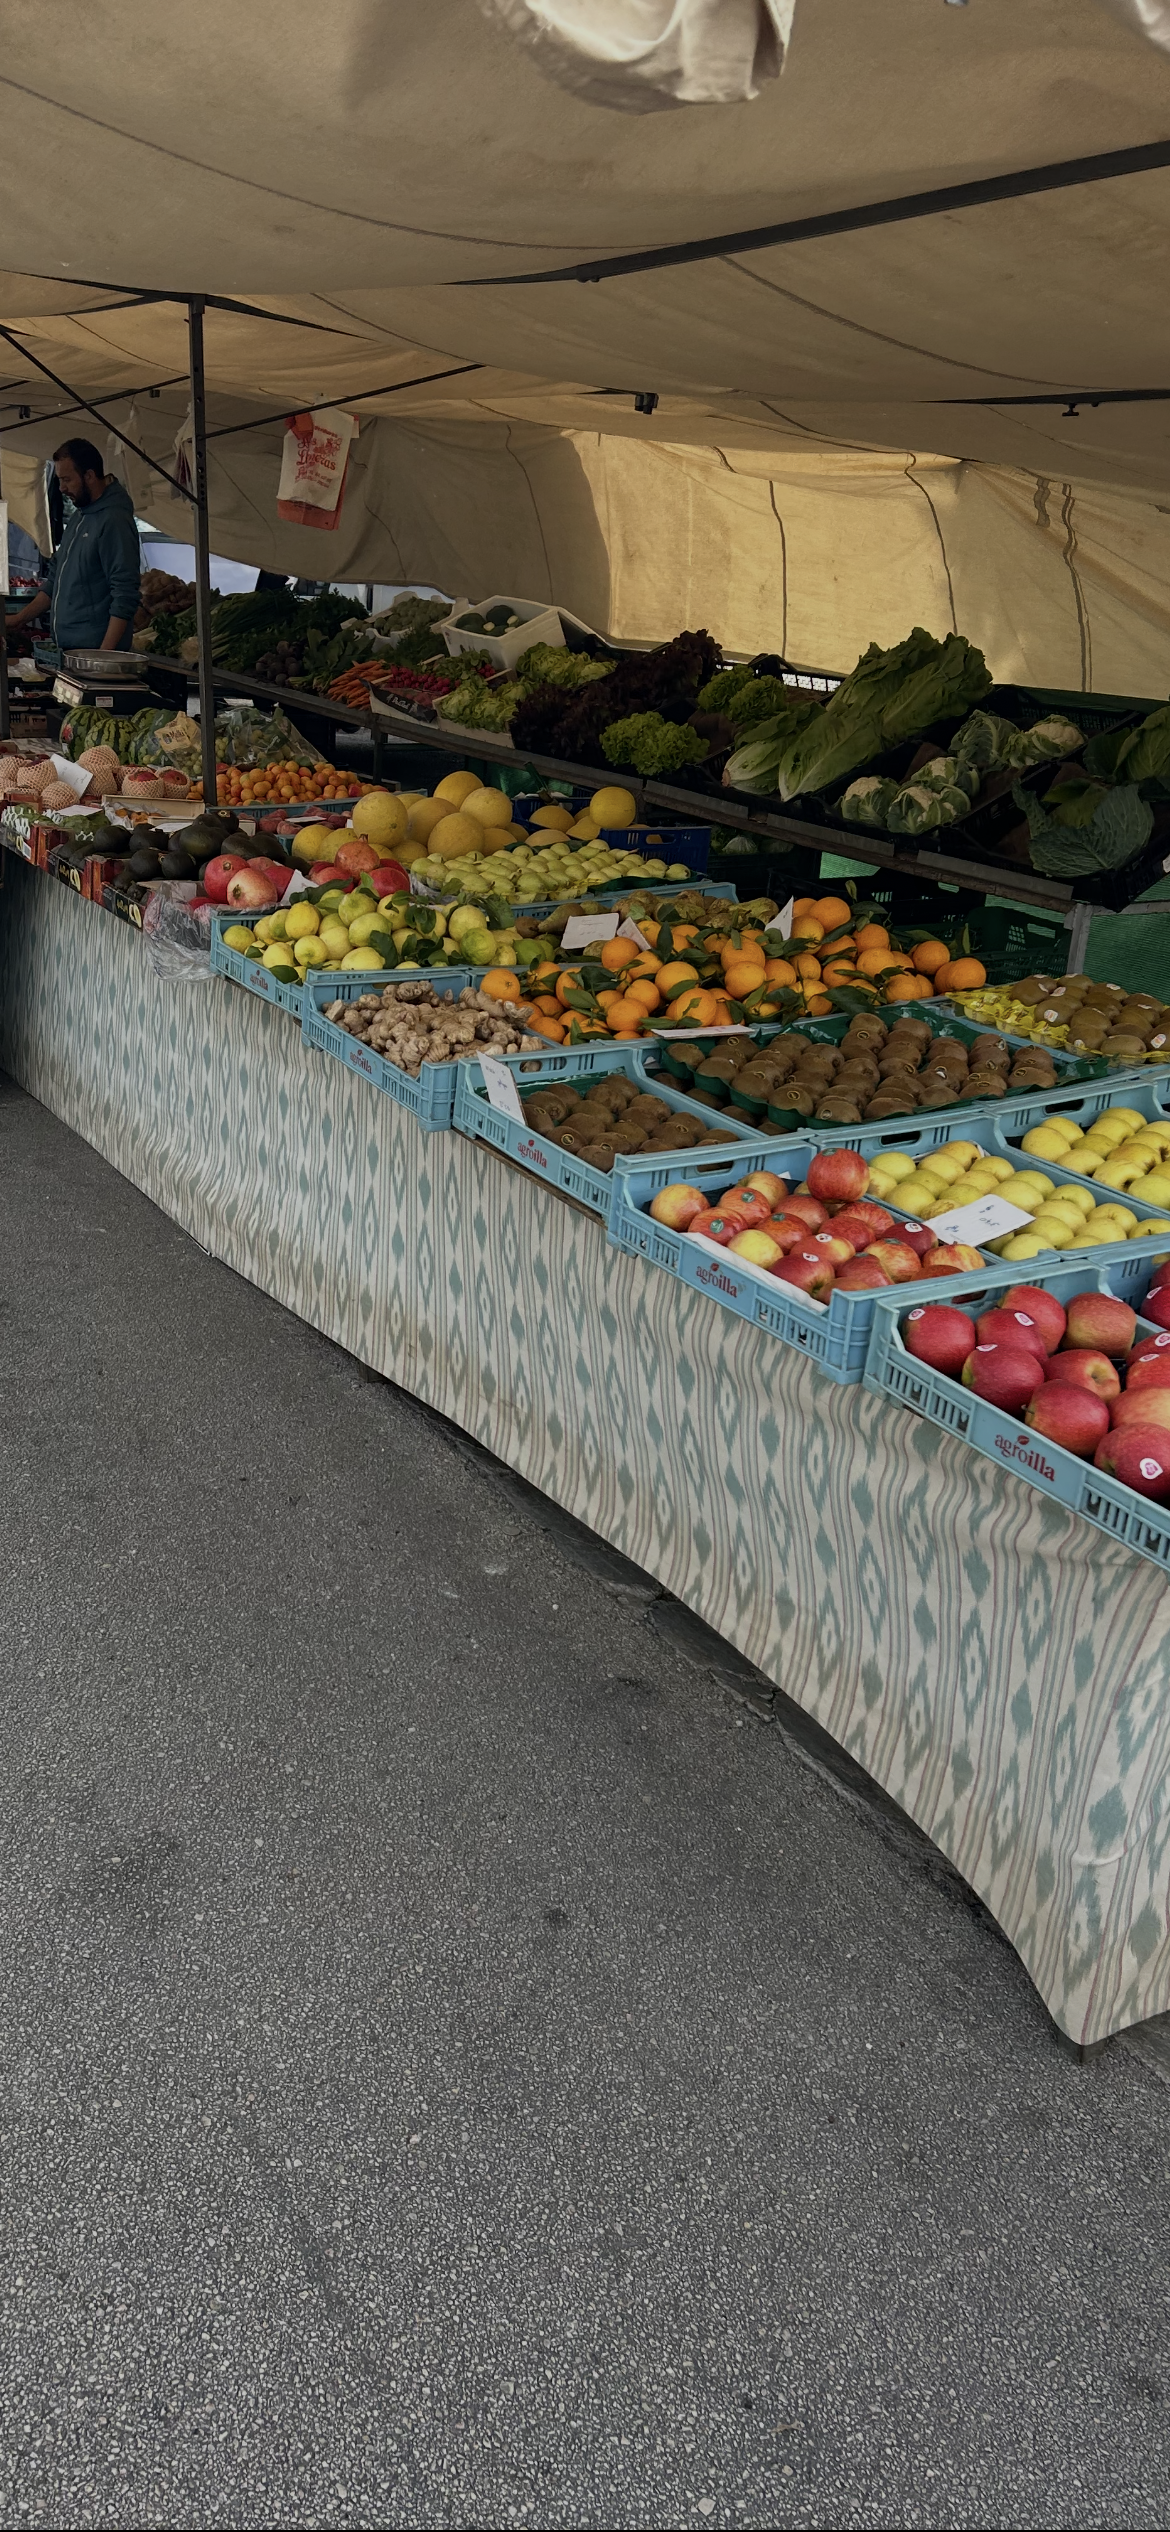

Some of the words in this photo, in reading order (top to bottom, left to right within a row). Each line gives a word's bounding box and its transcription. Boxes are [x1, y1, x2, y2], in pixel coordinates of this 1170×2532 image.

[517, 1141, 548, 1169] agroilla
[696, 1265, 738, 1299] agroilla
[995, 1434, 1056, 1482] agroilla
